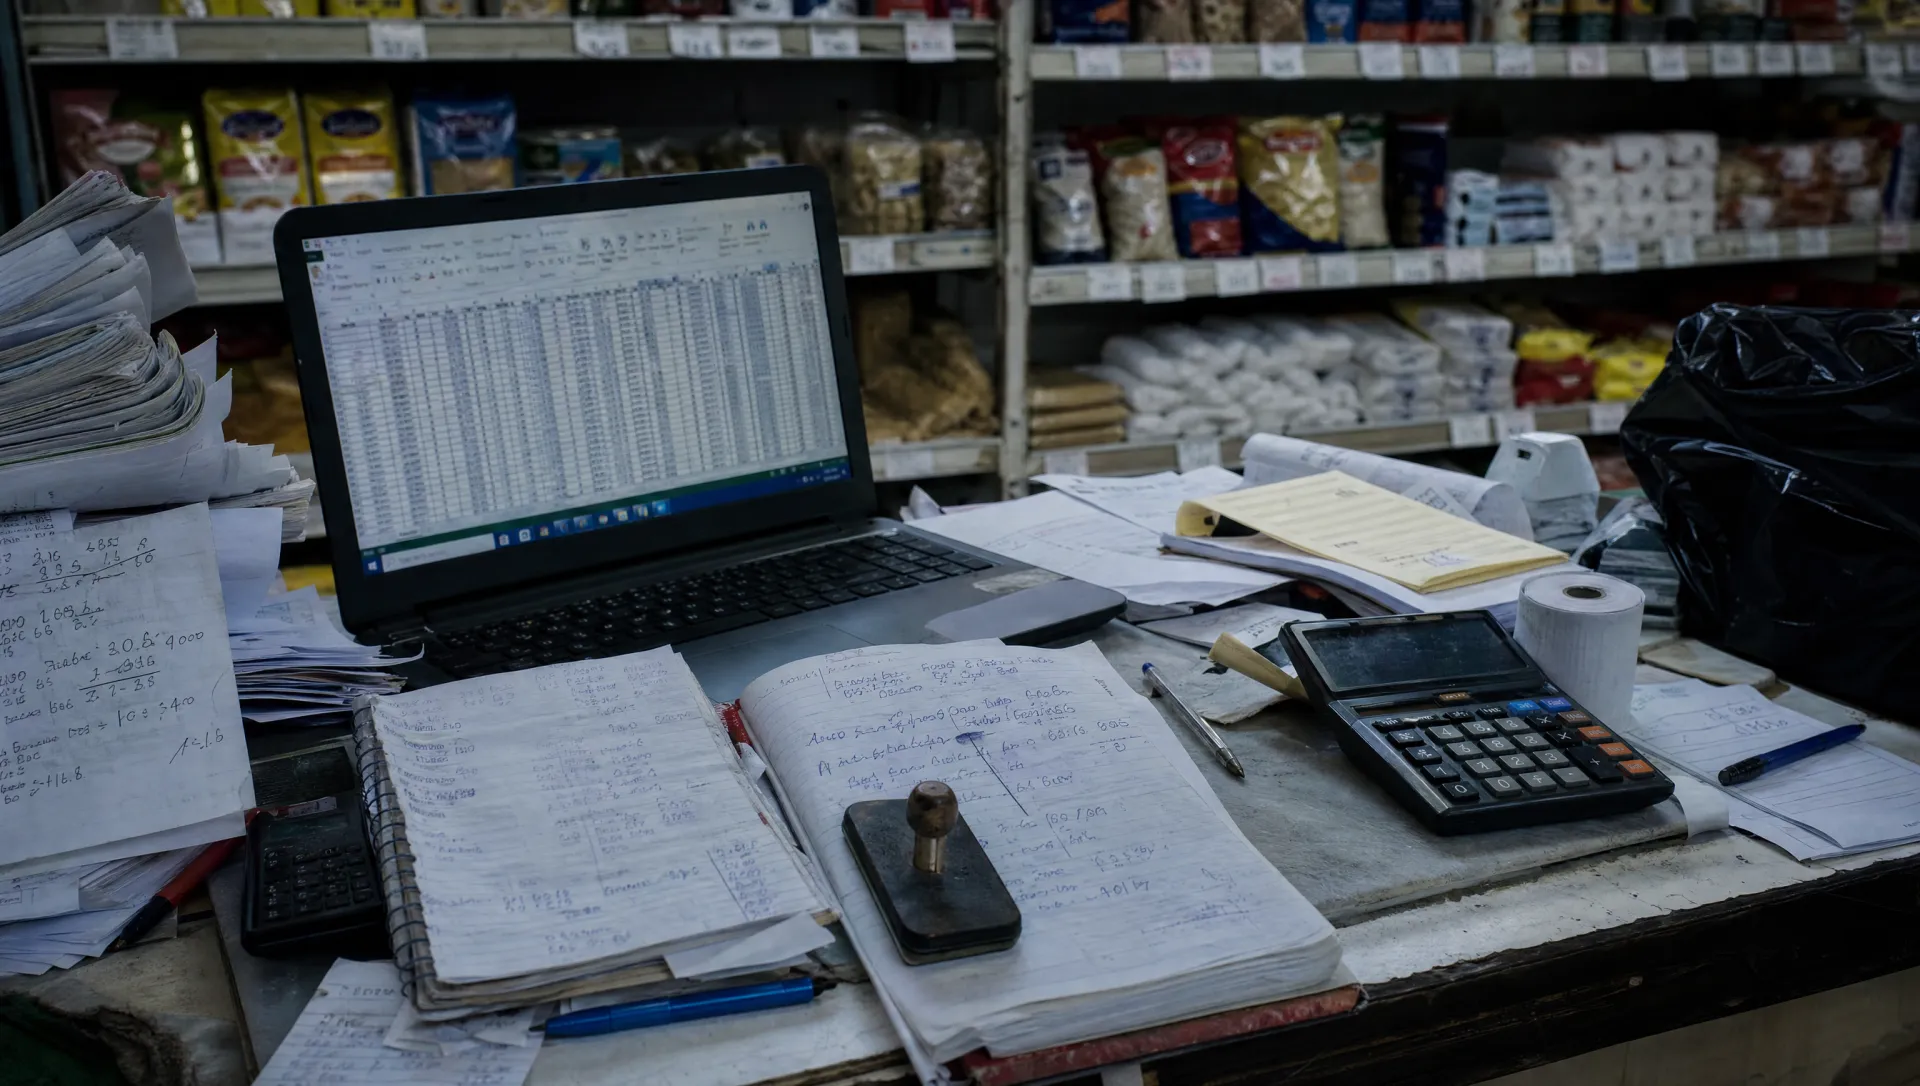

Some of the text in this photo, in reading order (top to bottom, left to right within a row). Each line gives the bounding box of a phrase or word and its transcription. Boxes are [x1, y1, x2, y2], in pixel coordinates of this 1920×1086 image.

[1511, 756, 1525, 766] 2
[1454, 778, 1511, 794] 0 0
